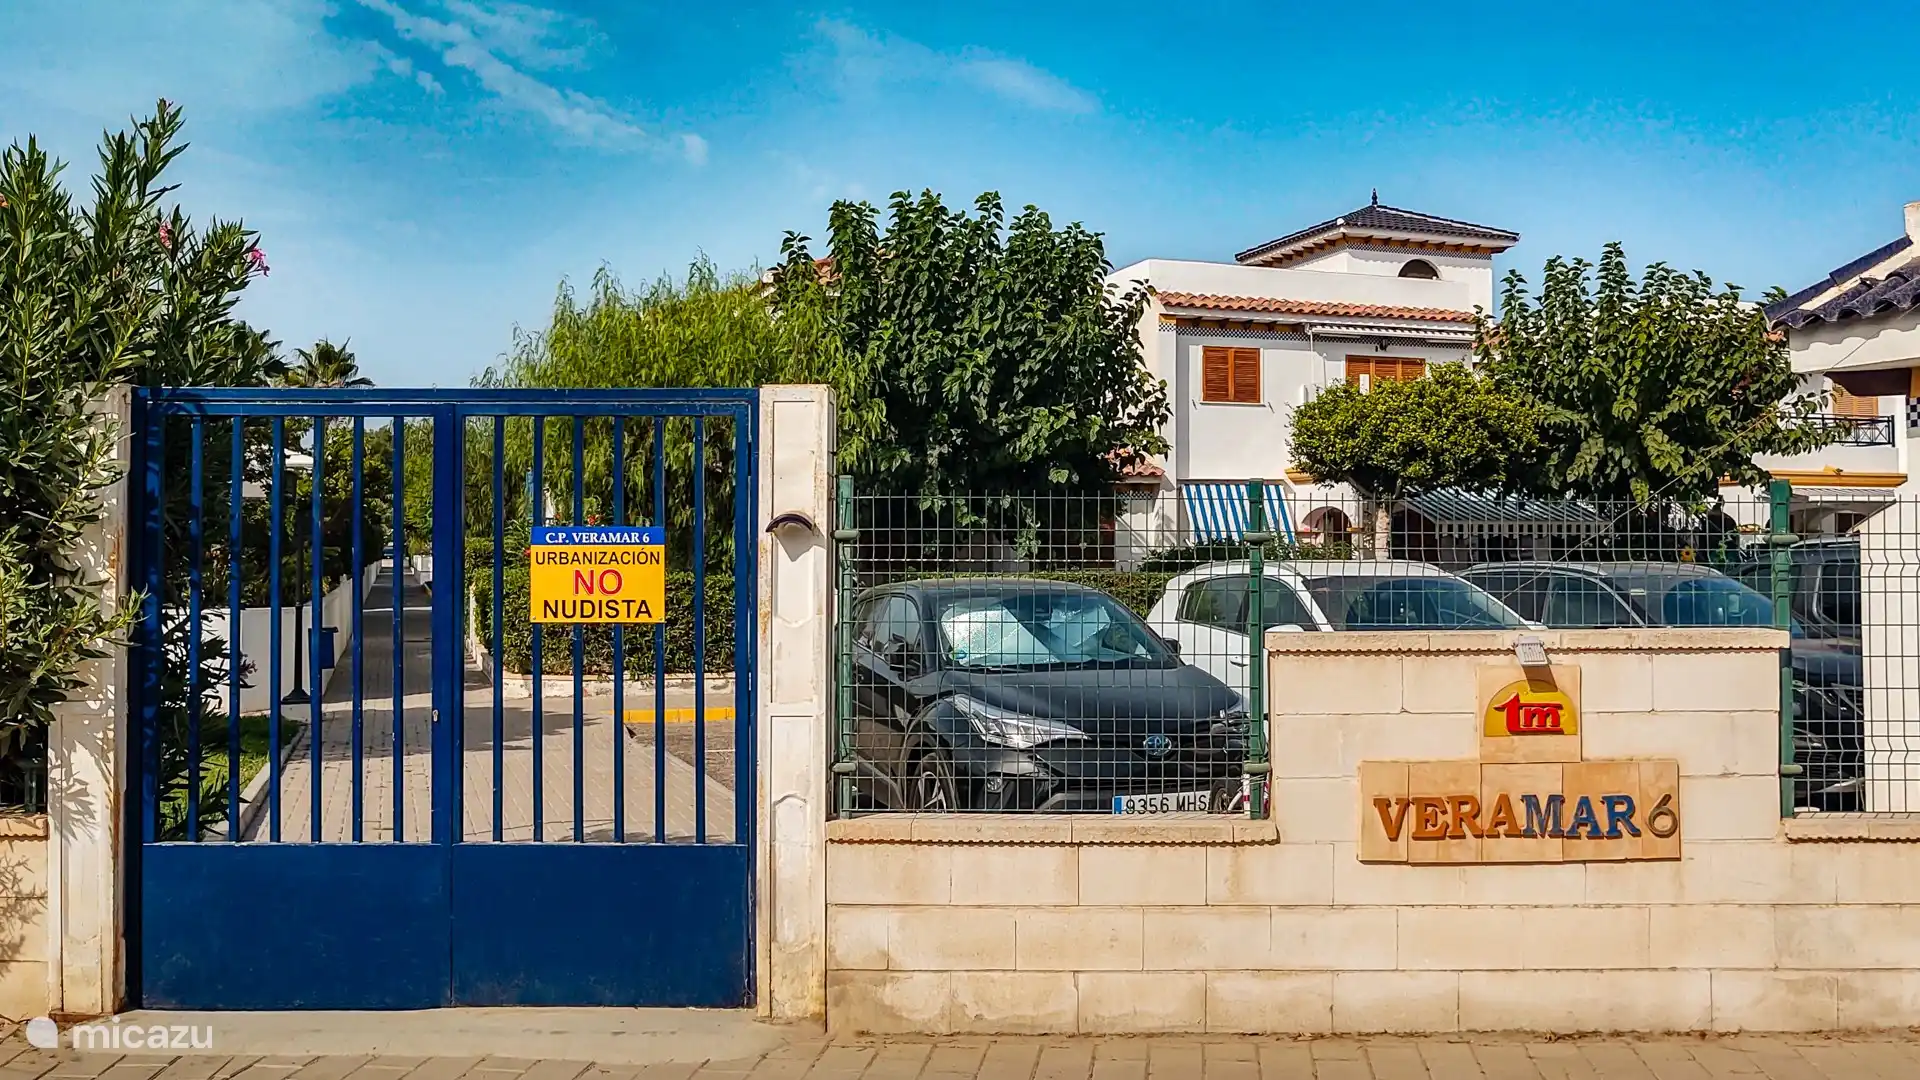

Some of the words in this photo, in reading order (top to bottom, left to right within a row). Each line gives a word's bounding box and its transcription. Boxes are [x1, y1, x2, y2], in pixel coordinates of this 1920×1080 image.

[546, 533, 569, 543] C.P.
[572, 533, 640, 543] VERAMAR
[642, 533, 650, 543] 6
[535, 548, 660, 565] URBANIZACIÓN
[573, 569, 623, 595] NO
[543, 599, 652, 618] NUDISTA
[1125, 798, 1169, 814] 9356
[1176, 795, 1208, 812] MHS
[1373, 794, 1642, 841] VERAMAR
[1648, 793, 1678, 838] 6
